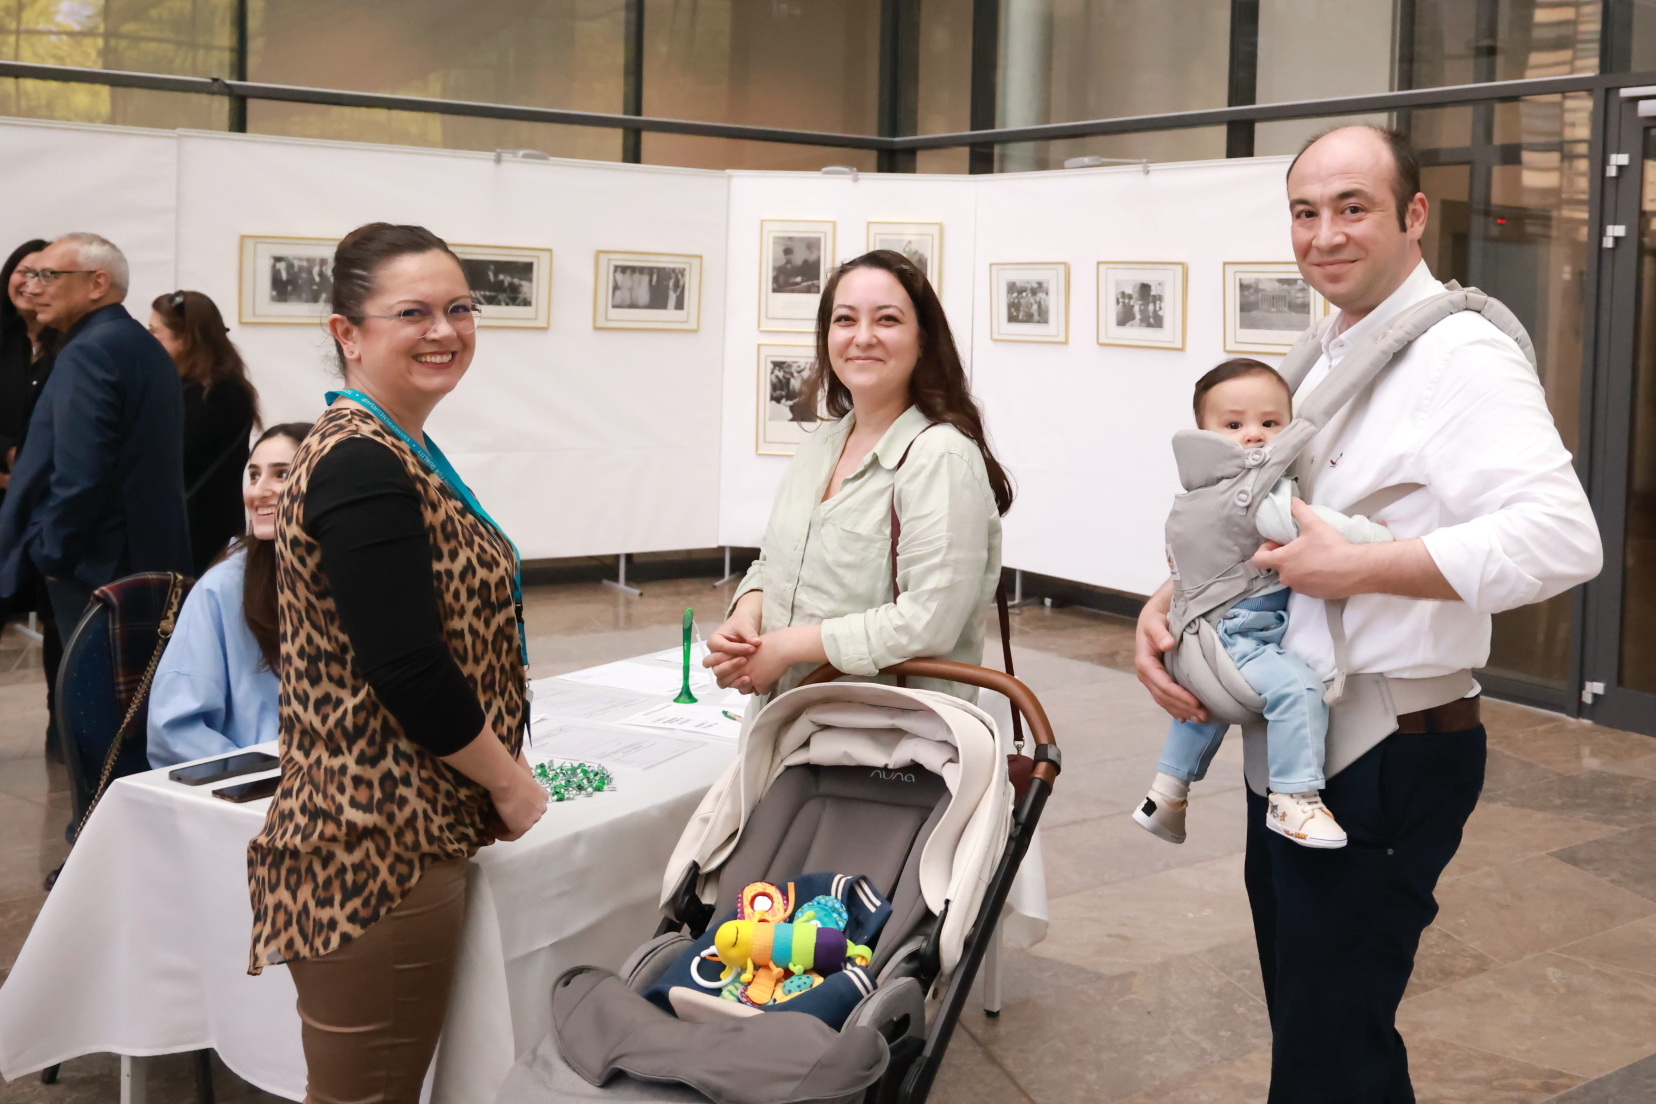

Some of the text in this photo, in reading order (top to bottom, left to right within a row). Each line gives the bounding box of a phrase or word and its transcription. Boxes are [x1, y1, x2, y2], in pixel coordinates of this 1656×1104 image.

[361, 397, 411, 442] ENTREPRENEURSHIP
[417, 449, 437, 470] QUALITY
[434, 468, 445, 479] FOR
